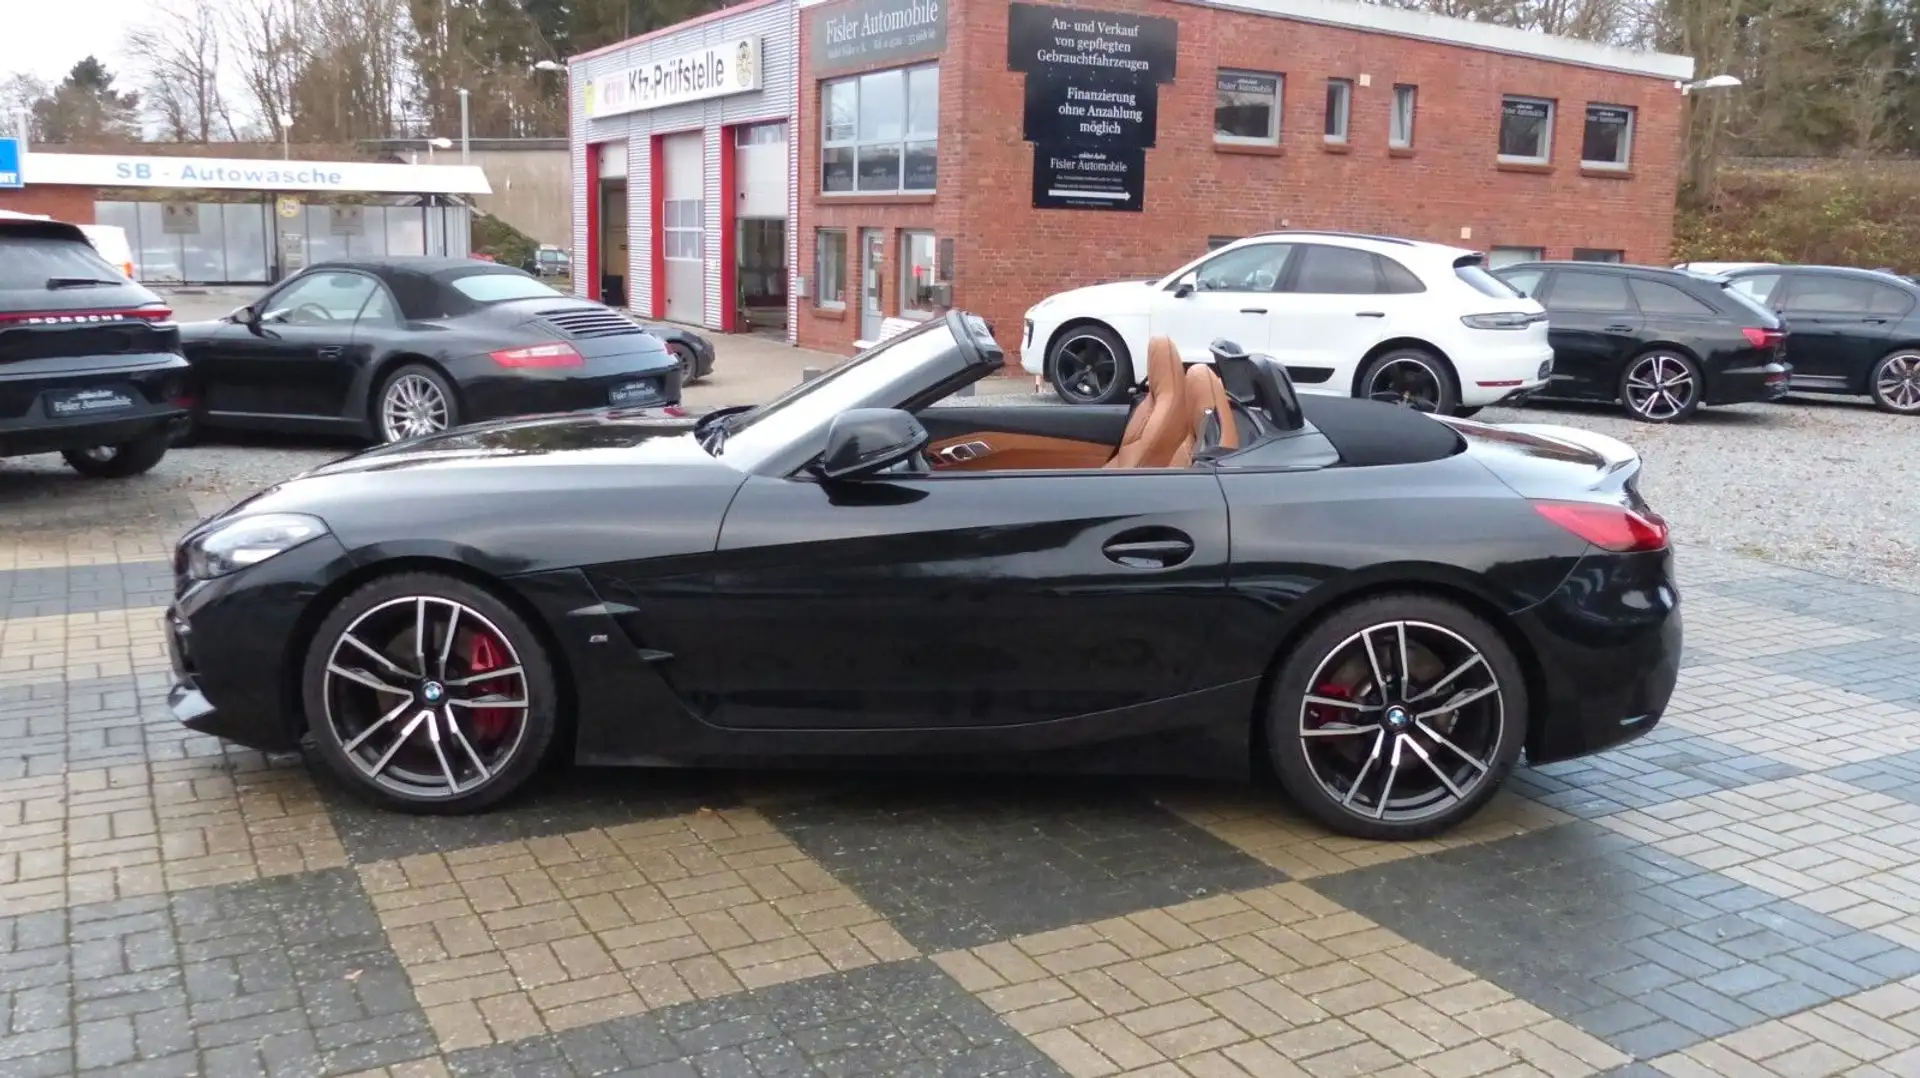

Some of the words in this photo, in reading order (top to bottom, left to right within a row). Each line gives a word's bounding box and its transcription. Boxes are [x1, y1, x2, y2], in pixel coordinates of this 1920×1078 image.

[825, 13, 859, 45] Fisler
[861, 0, 939, 37] Automobile
[1051, 17, 1072, 31] An-
[1074, 20, 1095, 33] und
[1097, 22, 1139, 37] Verkauf
[1055, 36, 1075, 48] von
[1077, 37, 1131, 53] gepflegten
[1037, 48, 1149, 71] Gebrauchtfahrzeugen
[628, 51, 724, 104] Kfz-Prüfstelle
[1067, 86, 1136, 106] Finanzierung
[1058, 102, 1085, 116] ohne
[1087, 104, 1143, 123] Anzahlung
[1080, 120, 1121, 136] möglich
[116, 161, 152, 180] SB
[181, 165, 343, 186] Autowasche
[1050, 157, 1076, 170] Fisler
[1078, 159, 1128, 173] Automobile
